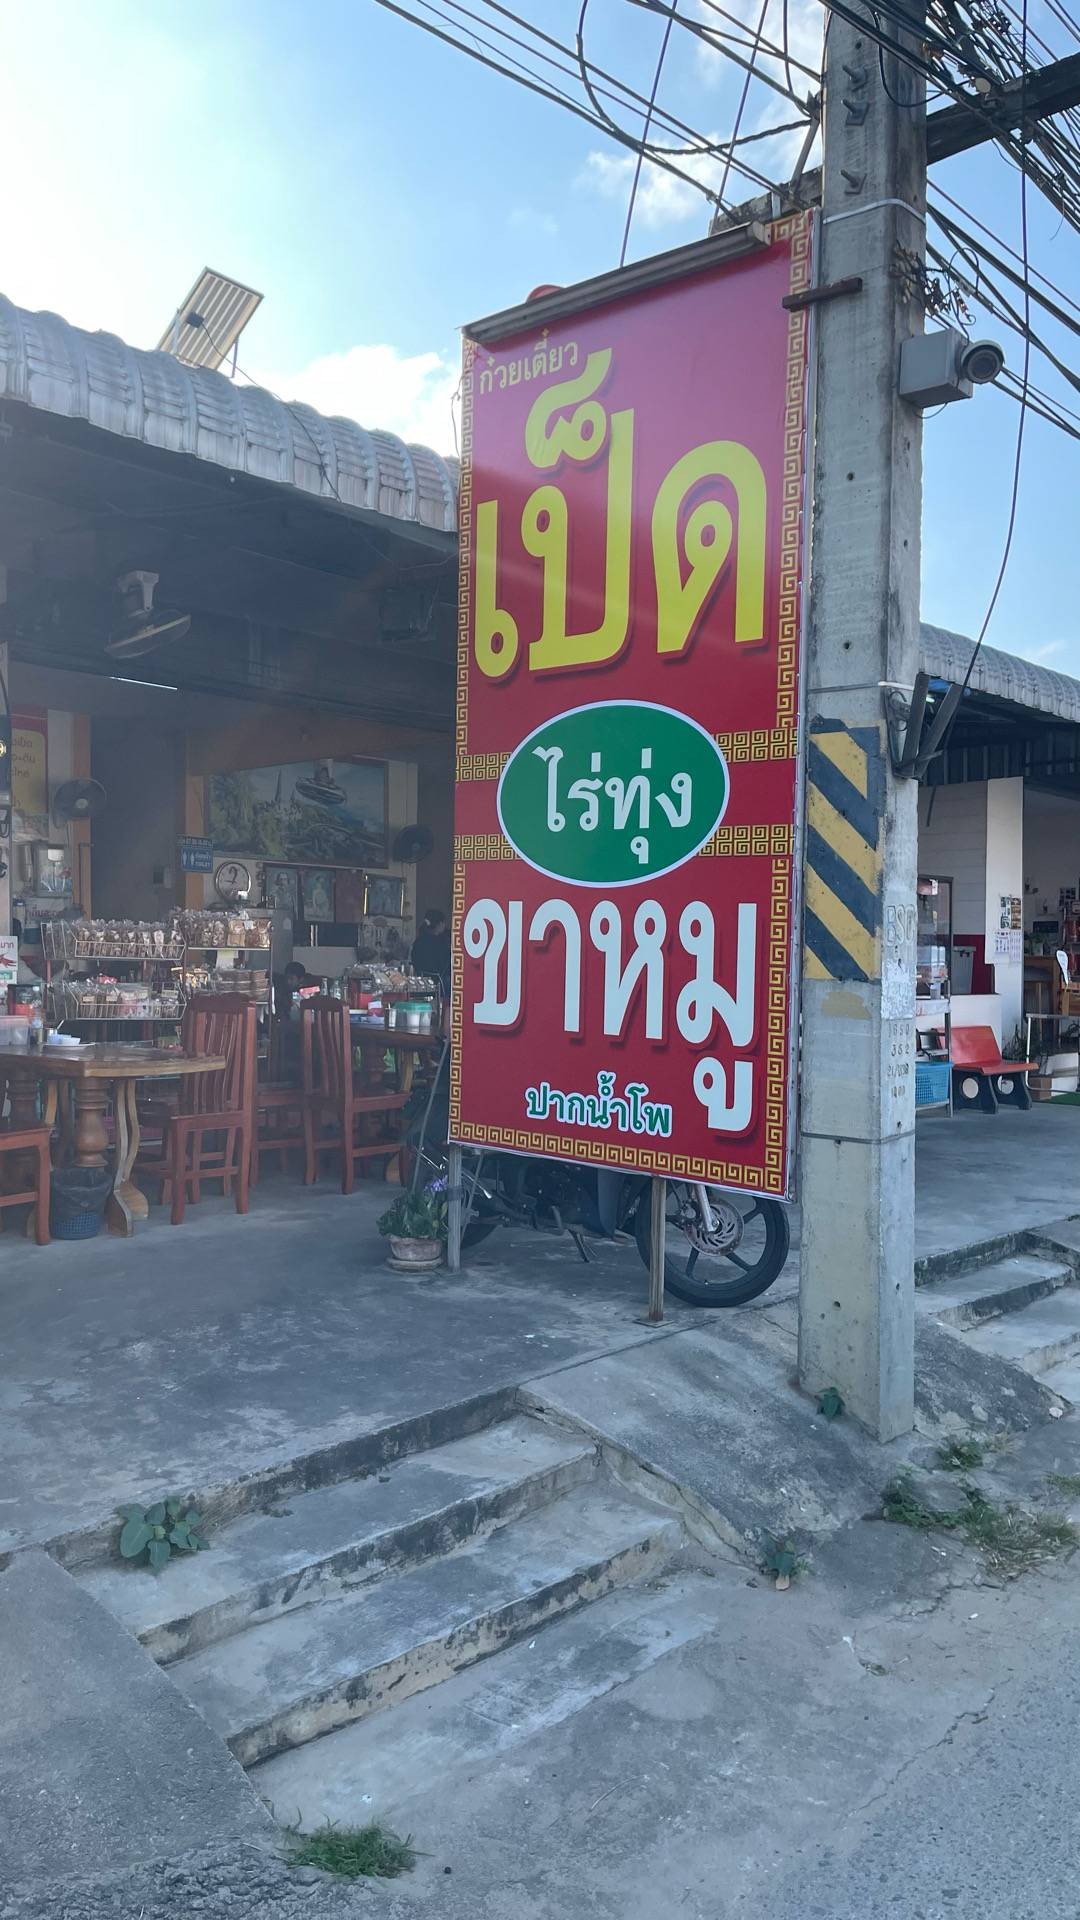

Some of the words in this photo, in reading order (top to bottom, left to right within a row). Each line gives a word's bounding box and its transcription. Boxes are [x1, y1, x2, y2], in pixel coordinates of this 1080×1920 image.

[480, 329, 578, 394] ก๋วยเตี๋ยว
[475, 348, 767, 677] เป็ด
[532, 745, 693, 864] ไร่ทุ่ง
[464, 898, 757, 1132] ขาหมู
[525, 1070, 673, 1137] ปากน้ำโพ
